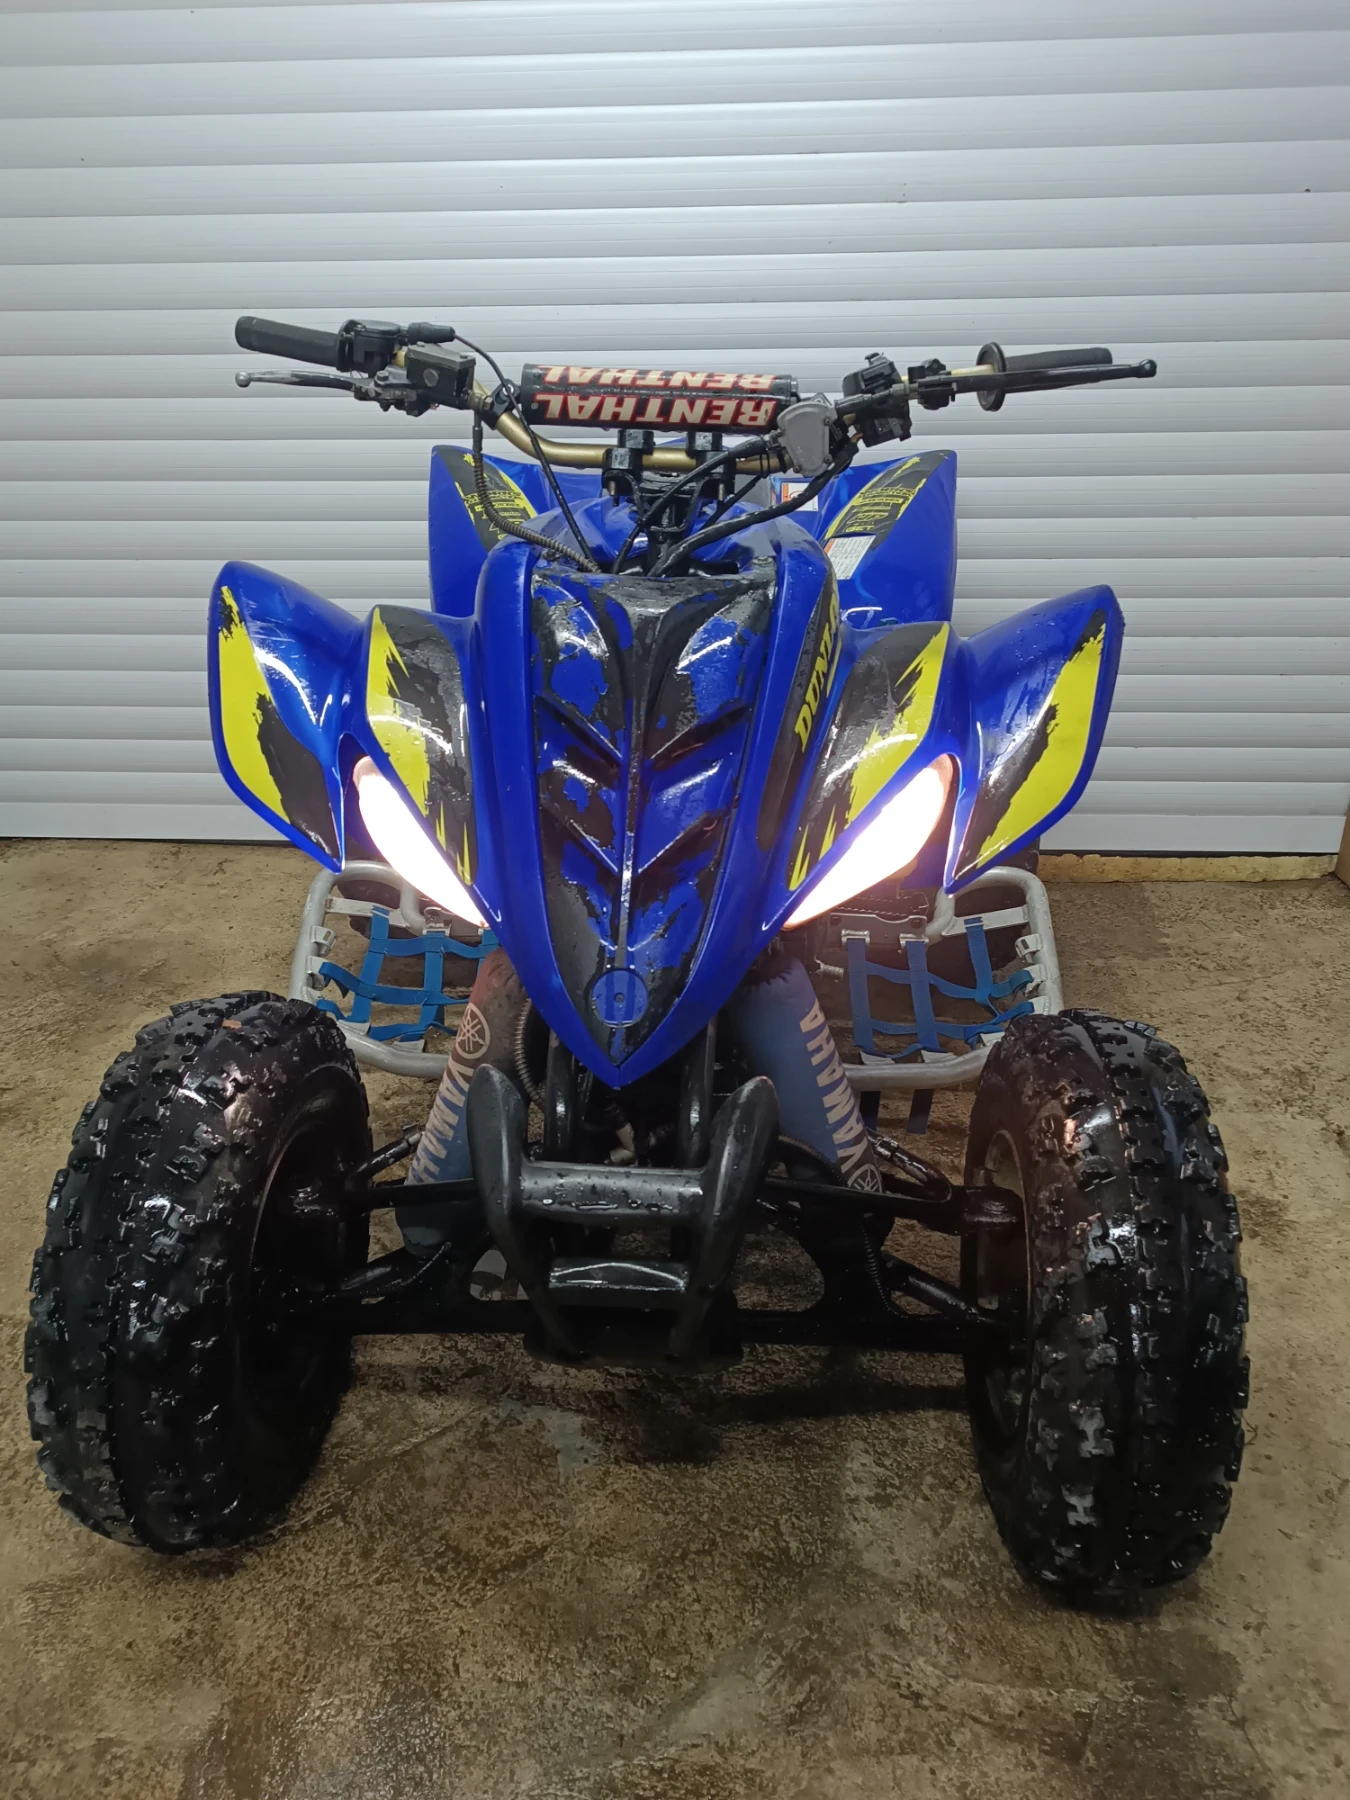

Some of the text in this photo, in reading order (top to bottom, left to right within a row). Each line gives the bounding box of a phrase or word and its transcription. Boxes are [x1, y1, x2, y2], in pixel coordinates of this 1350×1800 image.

[537, 365, 776, 390] RENTHAL
[535, 393, 777, 427] RENTHAL
[800, 998, 868, 1173] YAMAHA
